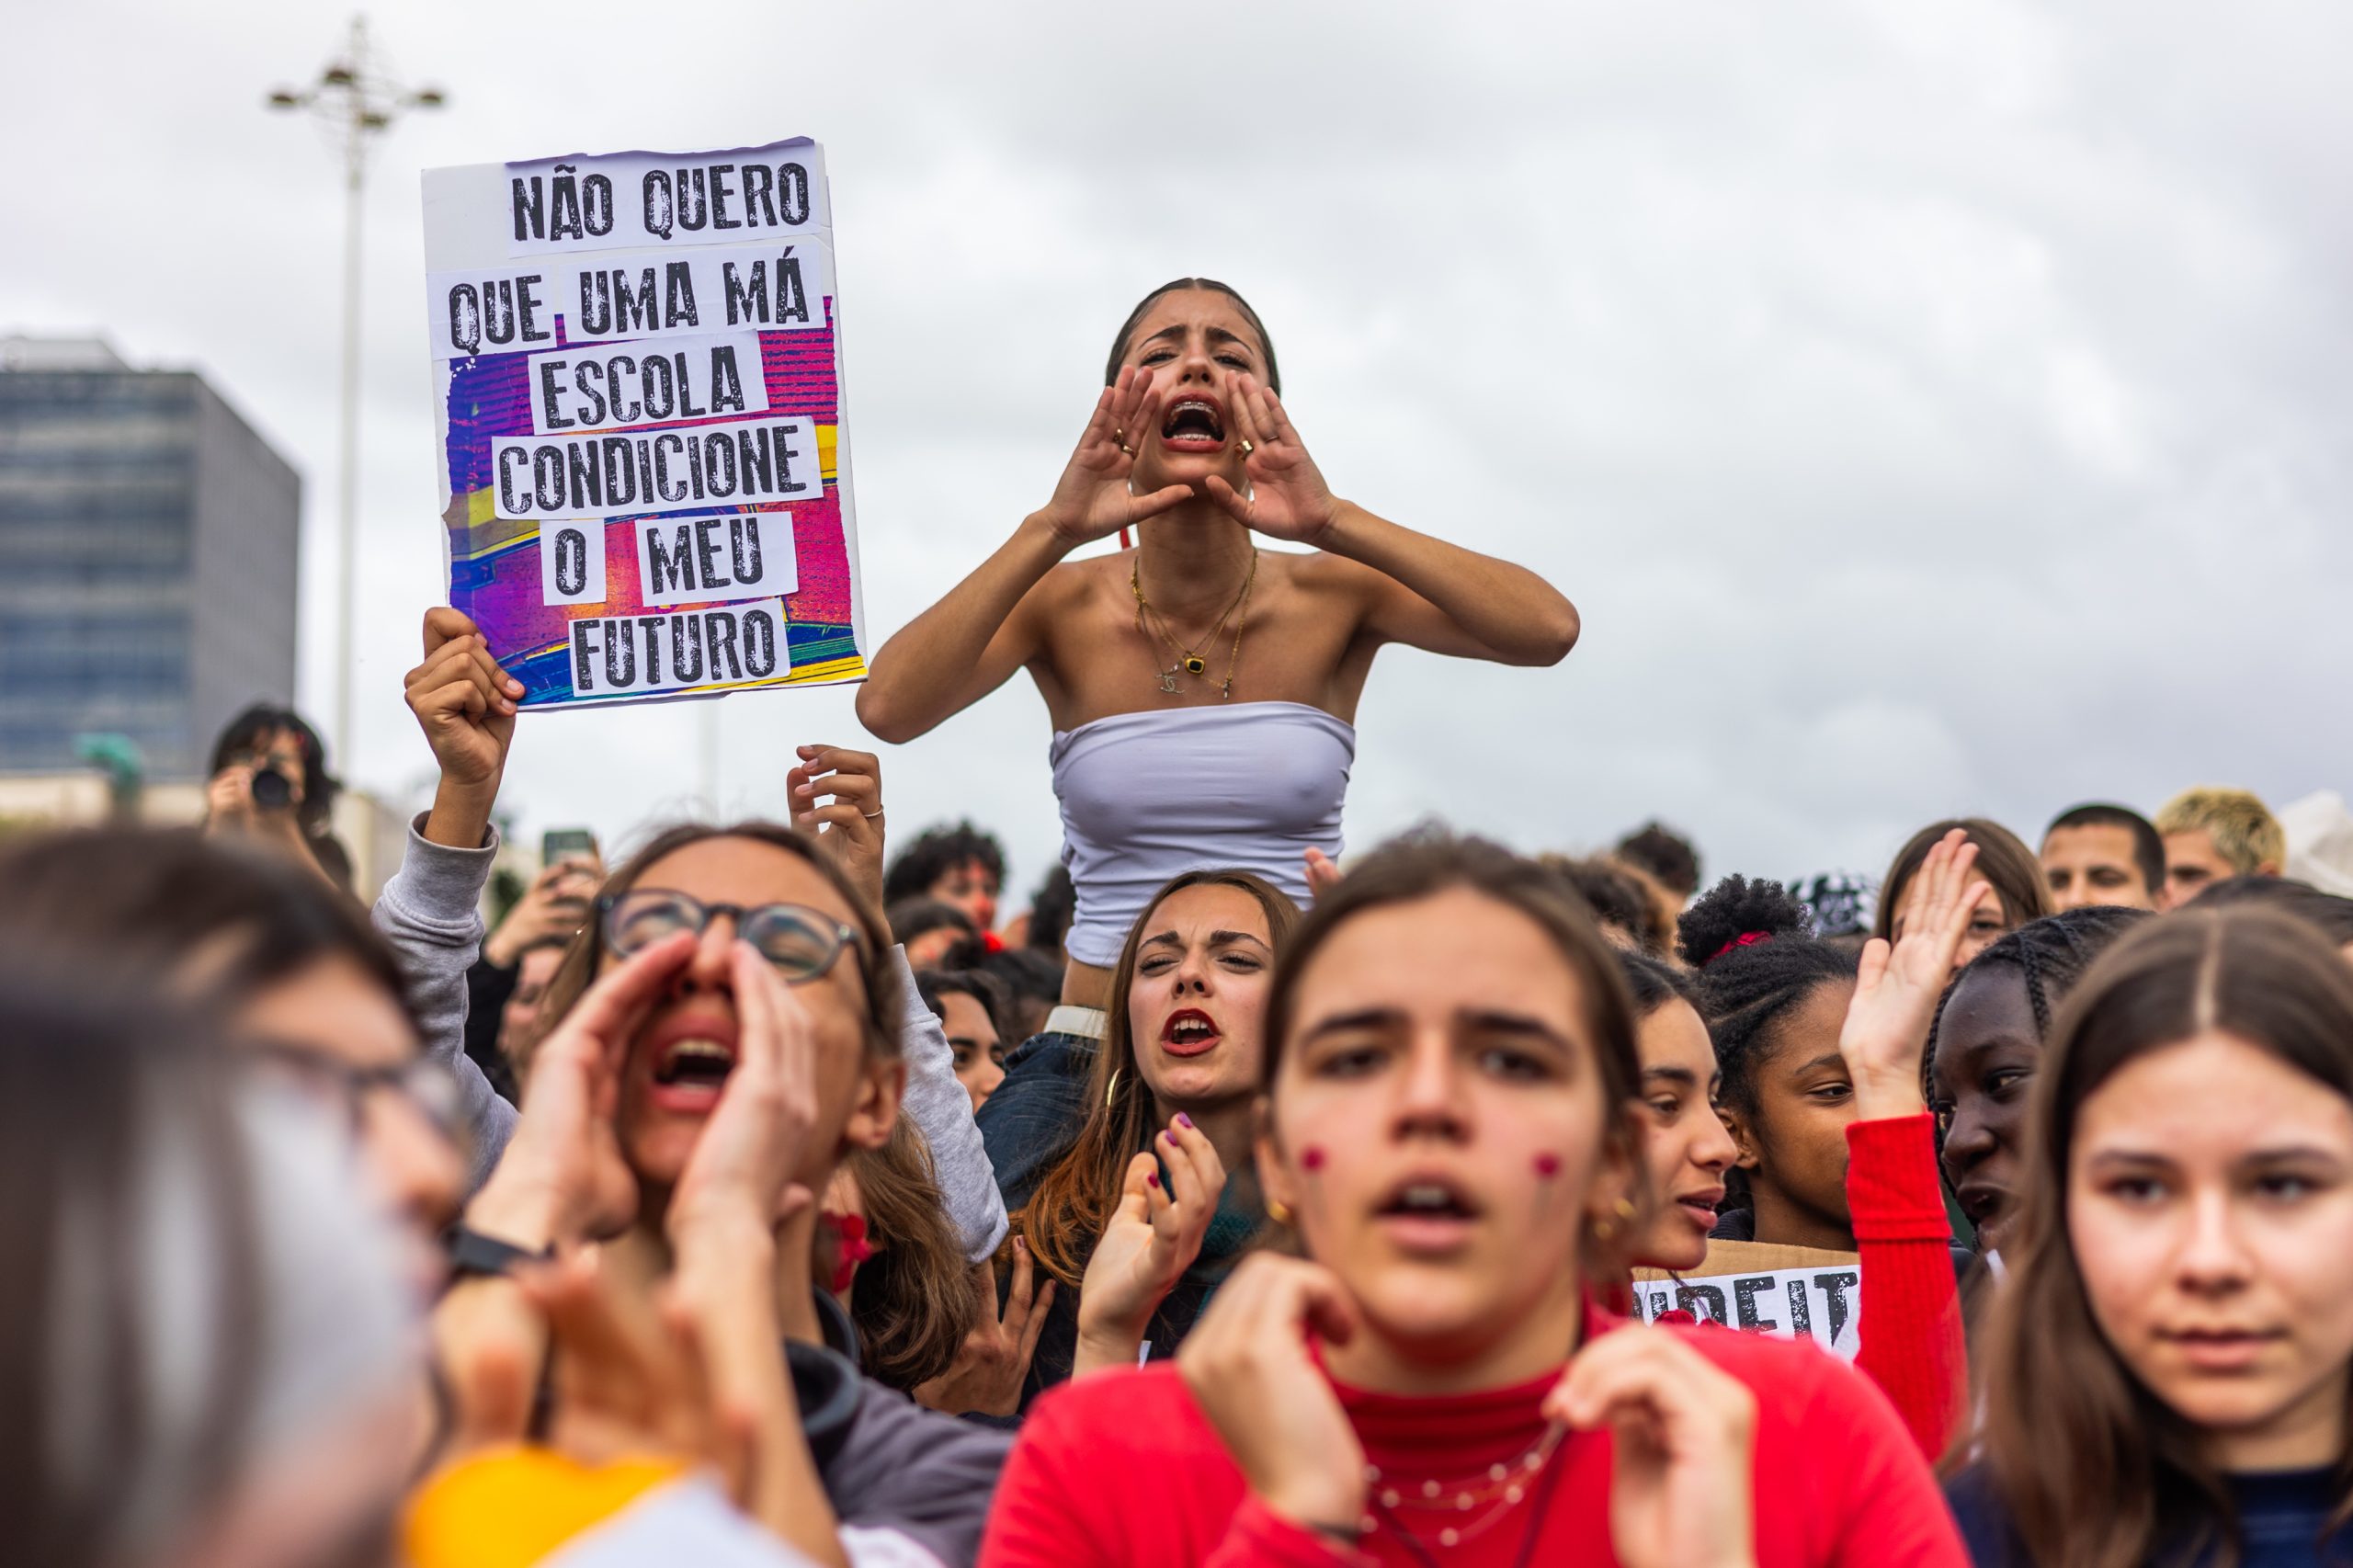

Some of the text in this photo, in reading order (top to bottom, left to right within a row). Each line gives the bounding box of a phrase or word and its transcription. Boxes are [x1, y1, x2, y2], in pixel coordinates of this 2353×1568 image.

[512, 162, 810, 241] NÃO QUERO
[449, 245, 810, 356] QUE UMA MÁ
[540, 345, 745, 429] ESCOLA
[499, 425, 807, 513] CONDICIONE
[555, 517, 764, 597] O MEU
[573, 609, 776, 690] FUTURO
